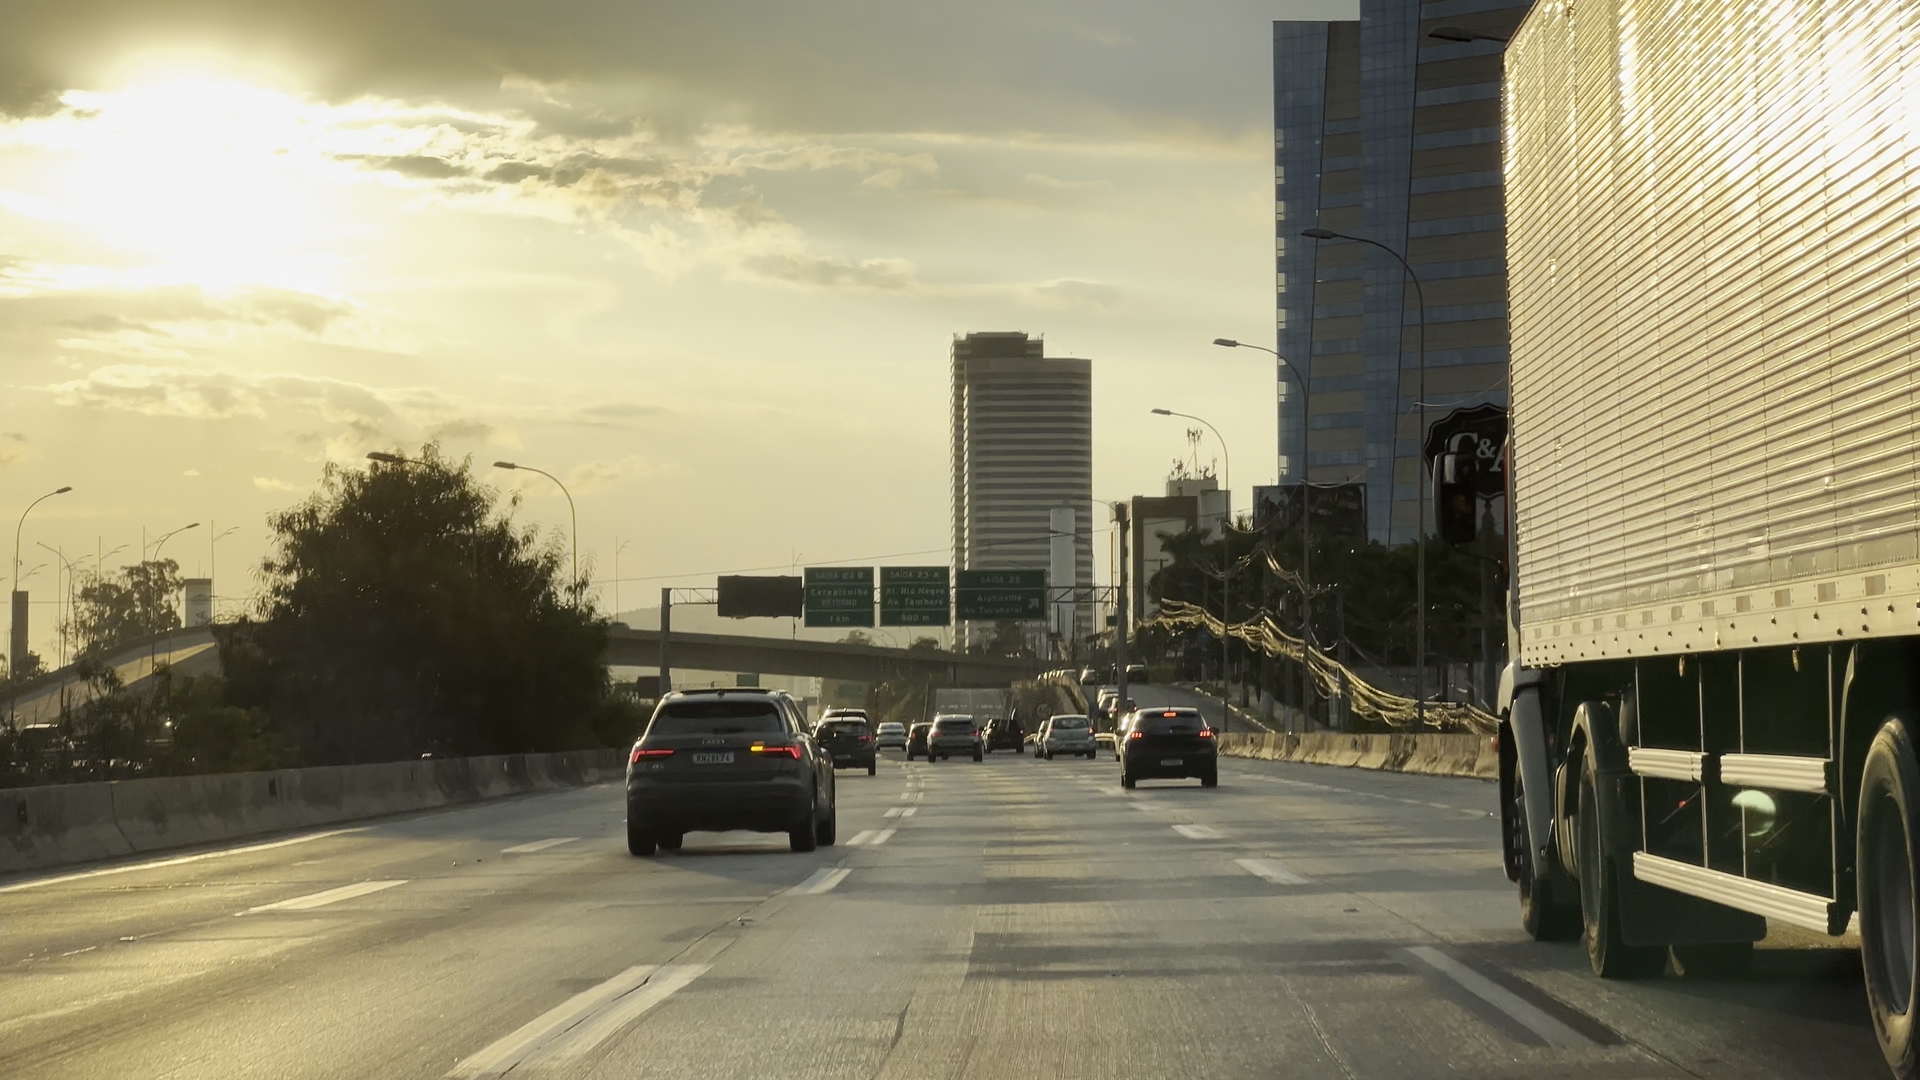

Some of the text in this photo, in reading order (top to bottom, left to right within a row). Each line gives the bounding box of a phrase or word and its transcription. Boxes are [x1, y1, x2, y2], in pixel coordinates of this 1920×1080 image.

[933, 571, 939, 579] A
[900, 587, 916, 595] Rio
[918, 587, 945, 597] Negro
